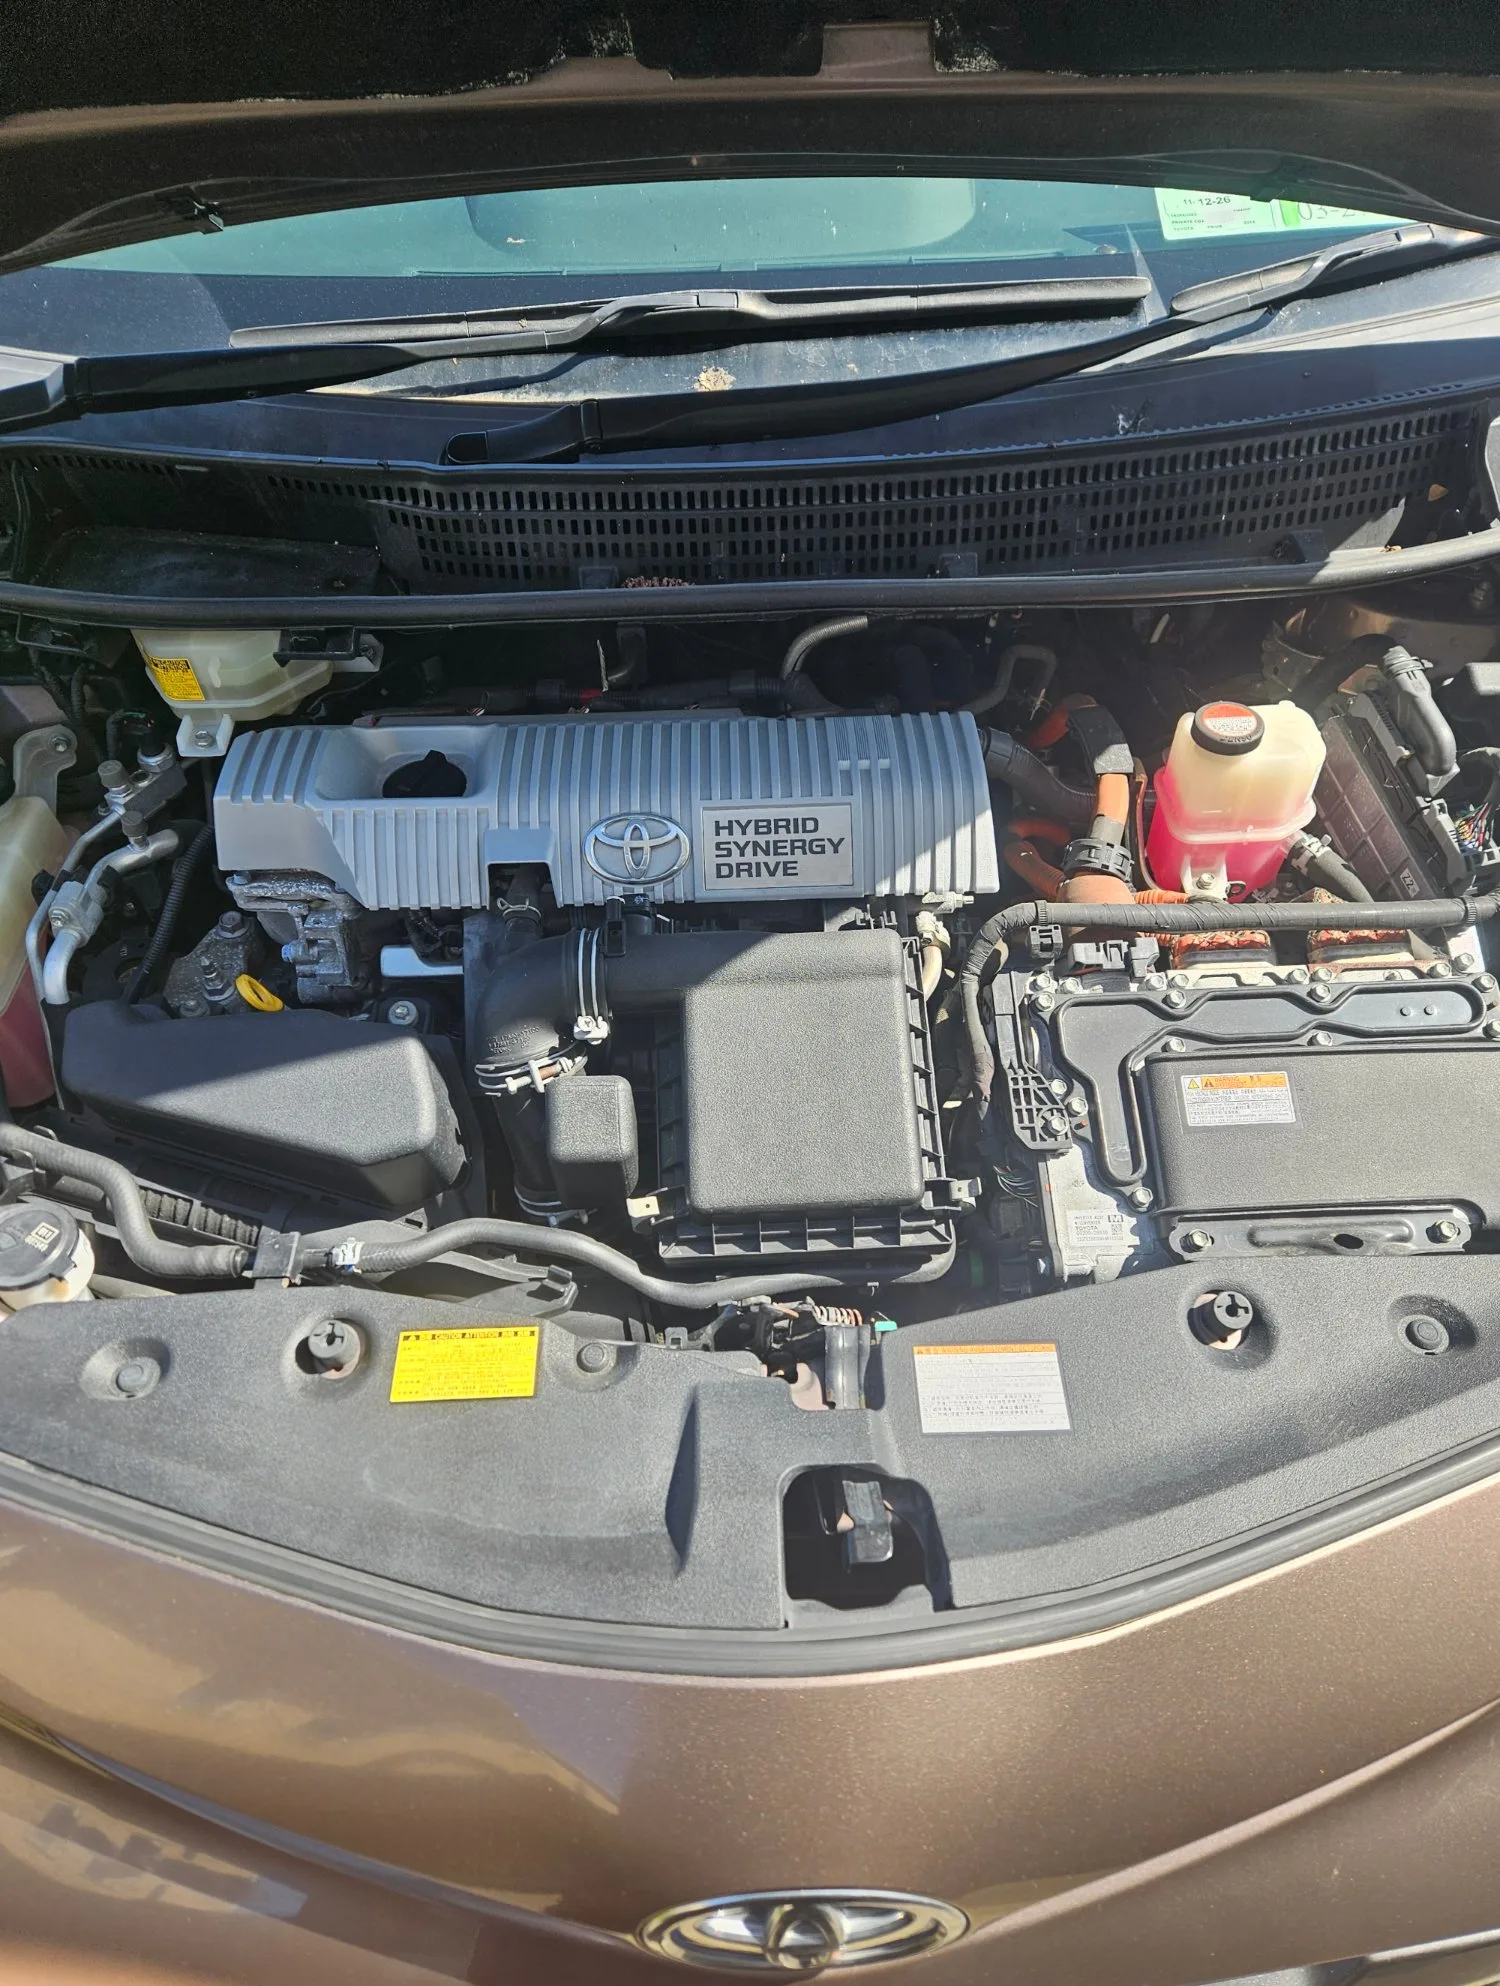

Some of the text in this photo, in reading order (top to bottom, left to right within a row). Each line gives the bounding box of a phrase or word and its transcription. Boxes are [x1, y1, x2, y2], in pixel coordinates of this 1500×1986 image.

[714, 817, 819, 836] HYBRID
[715, 837, 846, 858] SYNERGY
[715, 860, 799, 879] DRIVE
